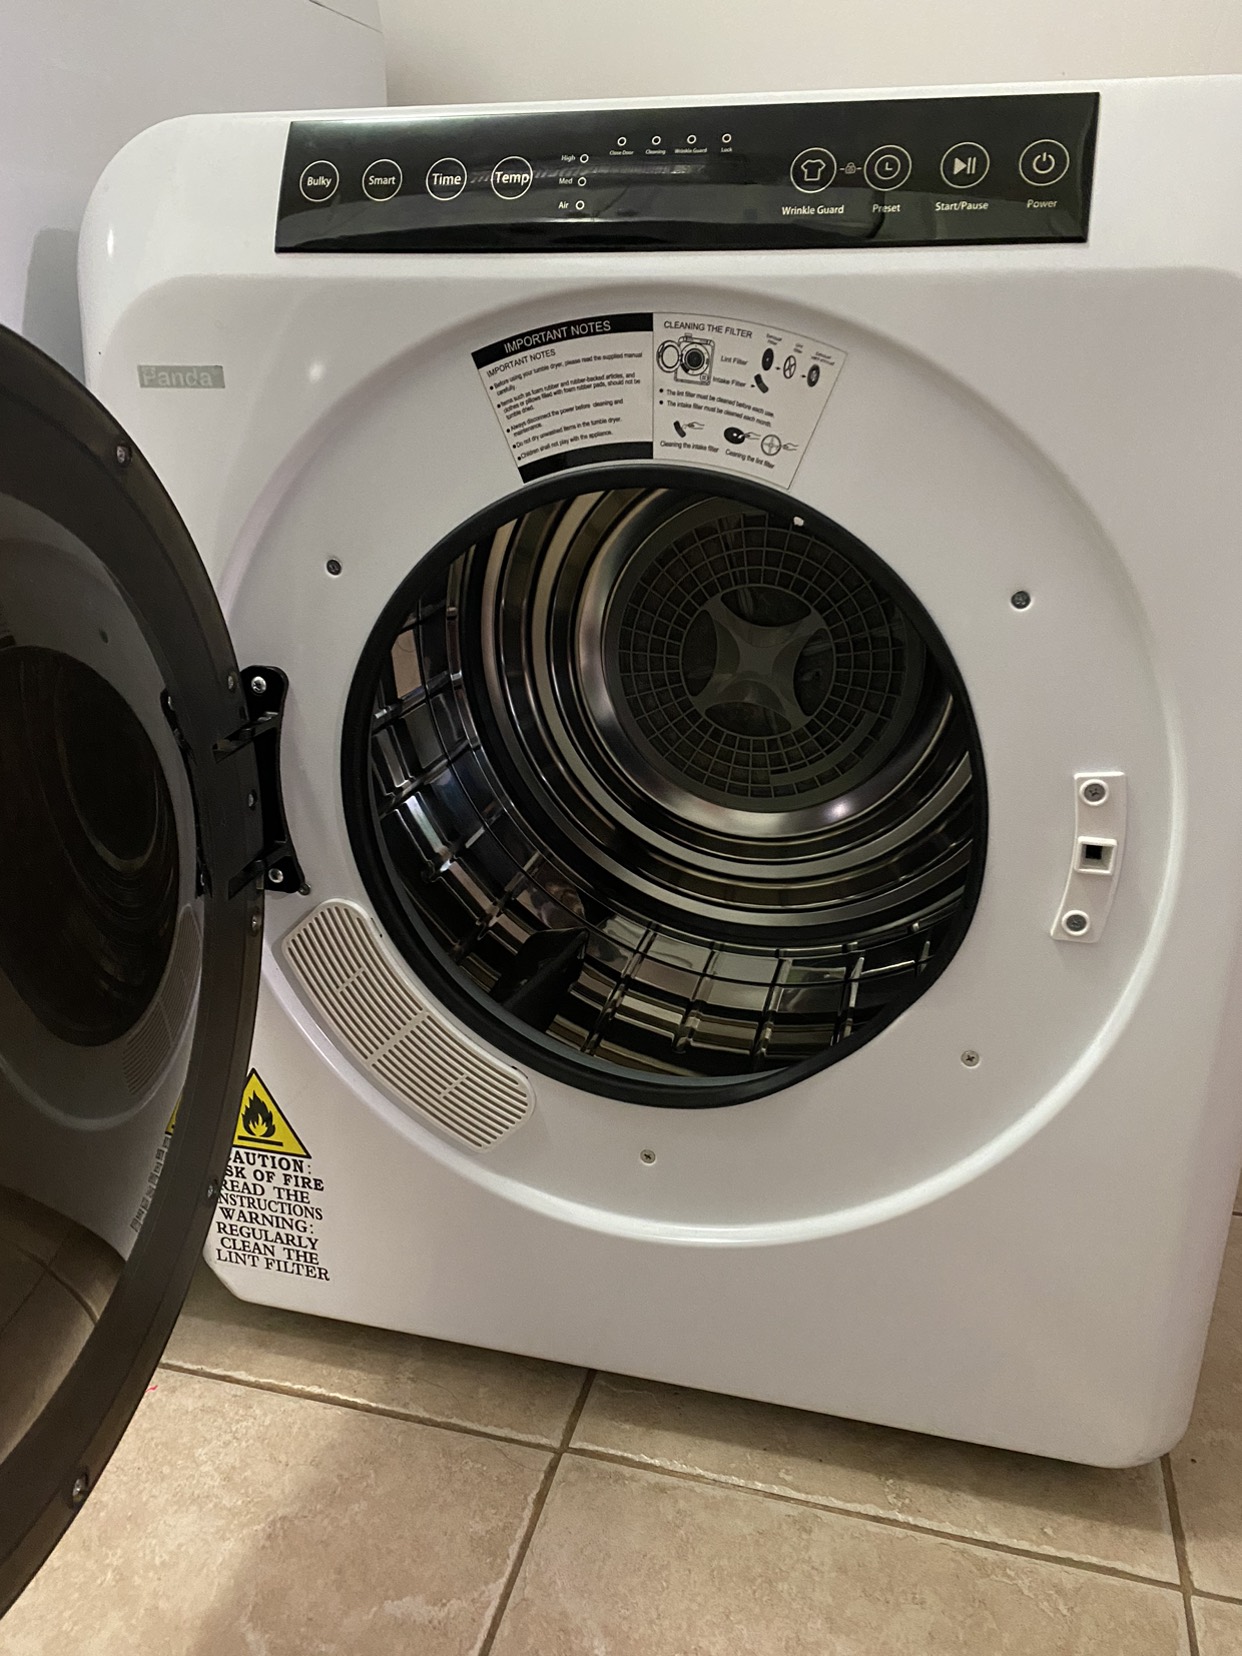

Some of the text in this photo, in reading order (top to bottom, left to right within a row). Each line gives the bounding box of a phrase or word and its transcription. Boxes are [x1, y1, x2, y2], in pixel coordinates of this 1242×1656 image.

[561, 154, 576, 162] High
[307, 176, 332, 188] Bulky
[368, 175, 396, 186] Smart
[432, 172, 462, 185] Time
[495, 171, 530, 186] Temp
[558, 200, 570, 209] Air
[781, 204, 844, 215] Wrinkle Guard
[872, 203, 901, 213] Preset
[935, 200, 989, 212] Start/Pause
[1027, 199, 1057, 208] Power
[503, 320, 612, 354] IMPORTANT NOTES
[663, 320, 705, 332] CLEANING
[707, 324, 724, 334] THE
[724, 326, 752, 339] FILTER
[486, 348, 556, 378] IMPORTANT NOTES
[721, 355, 748, 366] Lint Filter
[141, 366, 213, 386] Panda
[494, 379, 509, 389] Before
[509, 374, 522, 382] using
[522, 370, 532, 379] your
[533, 365, 550, 374] tumble
[564, 358, 580, 366] please
[602, 352, 623, 360] supplied
[712, 376, 746, 388] Intake Filter
[514, 393, 524, 401] such
[544, 383, 560, 391] rubber
[504, 404, 520, 414] clothes
[716, 397, 736, 406] cleaned
[736, 401, 752, 410] before
[752, 406, 764, 414] each
[506, 410, 522, 420] tumble
[510, 421, 526, 430] Always
[527, 412, 551, 424] disconnect
[560, 407, 574, 415] power
[593, 400, 613, 408] cleaning
[724, 410, 743, 418] cleaned
[591, 418, 607, 426] tumble
[660, 440, 682, 449] Cleaning
[520, 448, 539, 459] Children
[725, 448, 746, 461] Cleaning
[764, 460, 775, 469] filter
[229, 1150, 312, 1174] AUTION:
[226, 1165, 324, 1192] SK OF FIRE
[222, 1179, 310, 1204] READ THE
[218, 1192, 323, 1220] NSTRUCTIONS
[219, 1206, 314, 1234] WARNING:
[216, 1221, 319, 1250] REGULARLY
[220, 1236, 320, 1265] CLEAN THE
[216, 1248, 330, 1281] LINT FILTER
